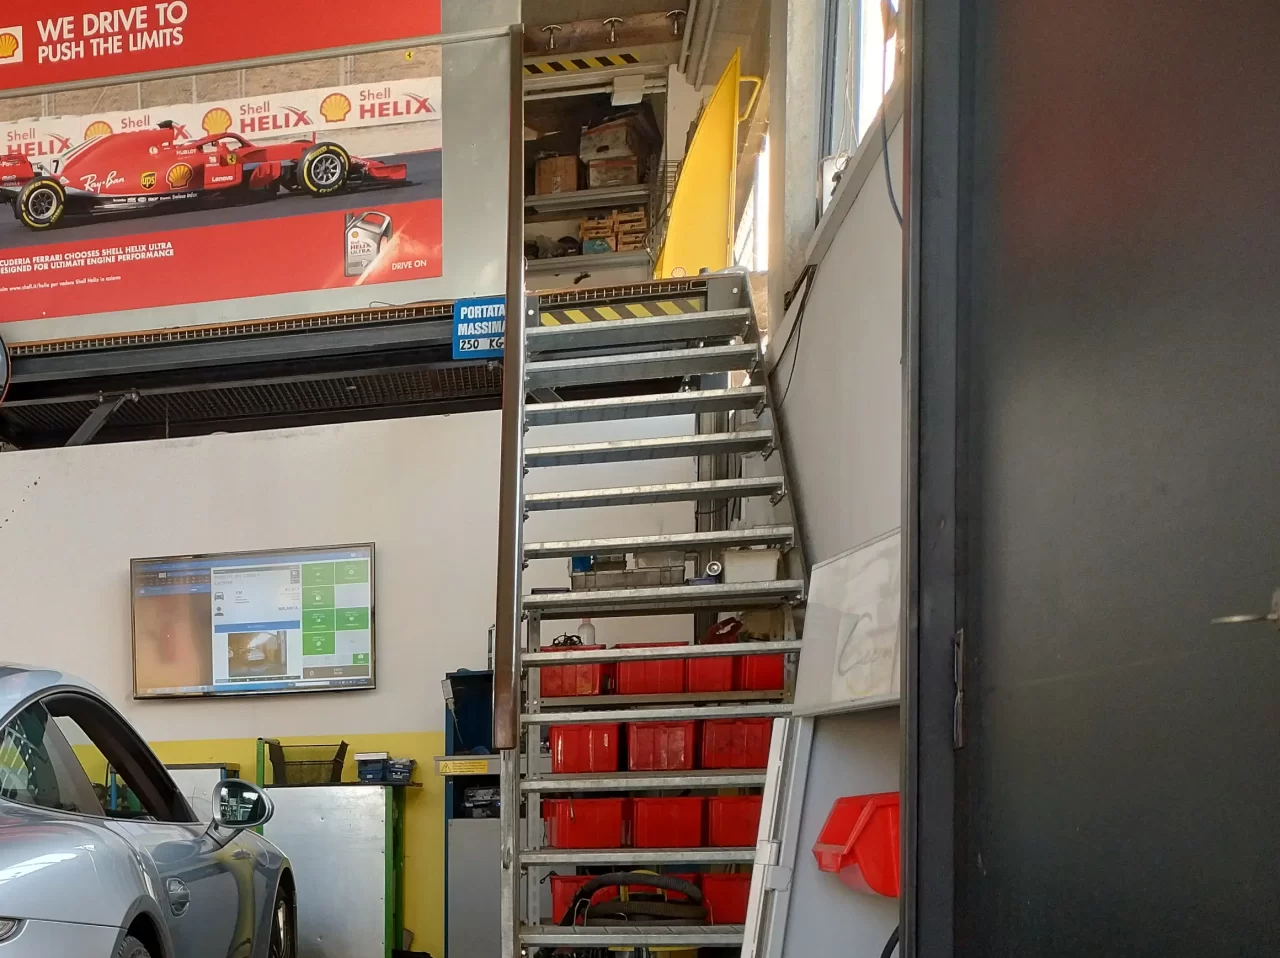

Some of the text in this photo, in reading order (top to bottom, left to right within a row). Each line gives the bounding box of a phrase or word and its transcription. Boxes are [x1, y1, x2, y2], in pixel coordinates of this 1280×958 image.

[37, 0, 188, 42] WE DRIVE TO
[38, 27, 183, 64] PUSH THE LIMITS
[359, 87, 391, 102] Shell
[239, 100, 270, 115] Shell
[359, 92, 436, 119] HELIX
[121, 115, 150, 129] Shell
[239, 105, 313, 133] HELIX
[7, 128, 36, 142] Shell
[6, 133, 72, 157] HELIX
[52, 160, 59, 174] 7
[141, 175, 155, 186] ups
[212, 174, 233, 183] Lenovo
[32, 253, 62, 263] FERRARI
[64, 249, 100, 260] CHOOSES
[102, 247, 123, 256] SHELL
[125, 244, 146, 253] HELIX
[148, 242, 172, 251] ULTRA
[350, 242, 372, 250] HELIX
[34, 263, 49, 271] FOR
[51, 259, 85, 269] ULTIMATE
[87, 256, 115, 265] ENGINE
[118, 249, 174, 262] PERFORMANCE
[392, 259, 427, 270] DRIVE ON
[460, 304, 505, 319] PORTATA
[460, 338, 504, 350] 250 KG
